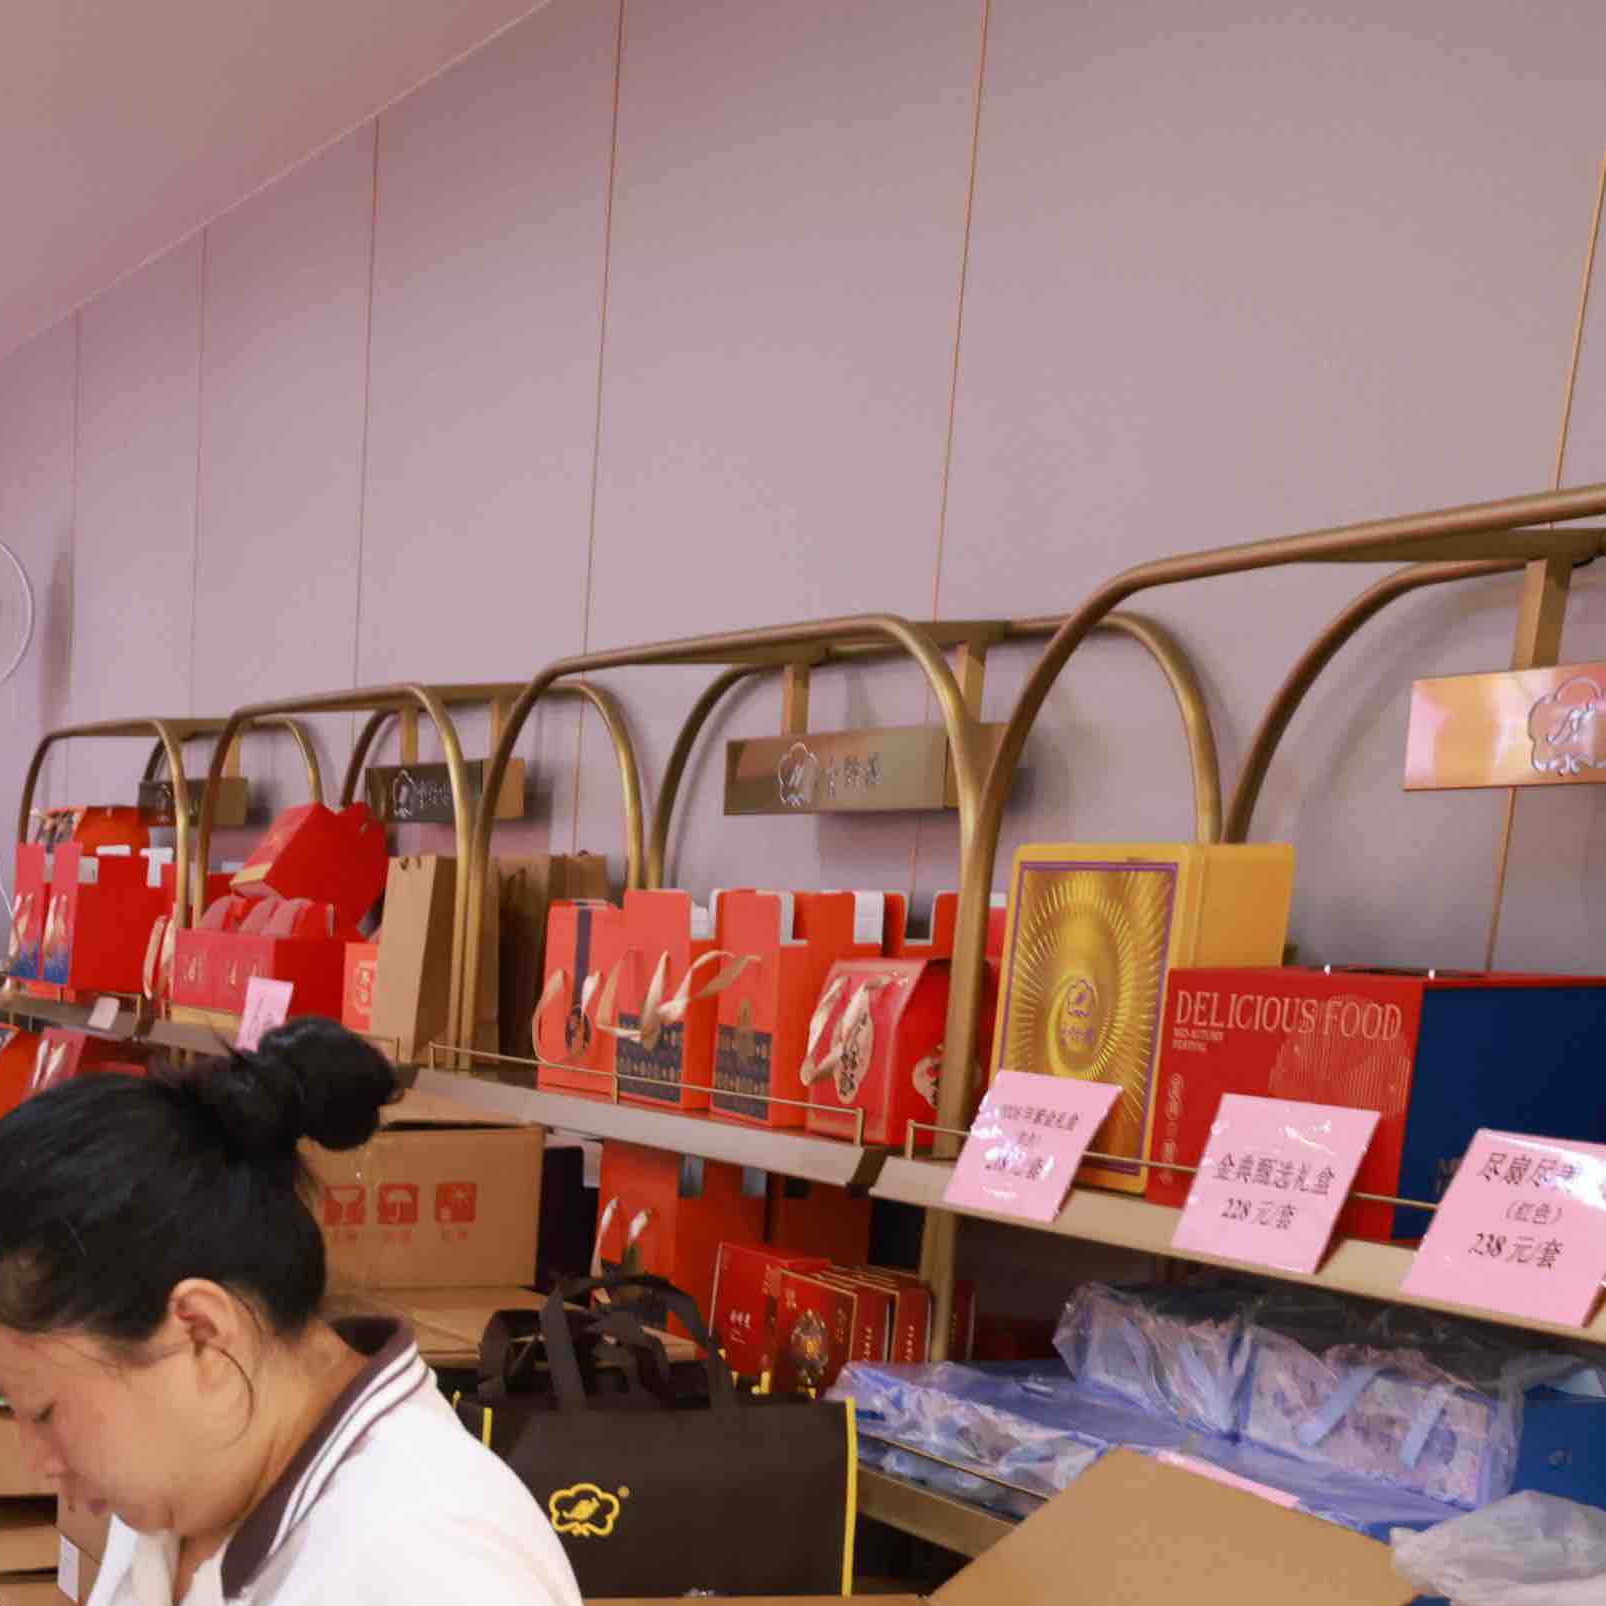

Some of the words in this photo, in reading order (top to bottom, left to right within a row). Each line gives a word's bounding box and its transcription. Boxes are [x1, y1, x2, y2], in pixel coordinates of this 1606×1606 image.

[1175, 990, 1318, 1034] DELICIOUS
[1323, 997, 1403, 1041] FOOD
[1468, 1231, 1508, 1260] 238
